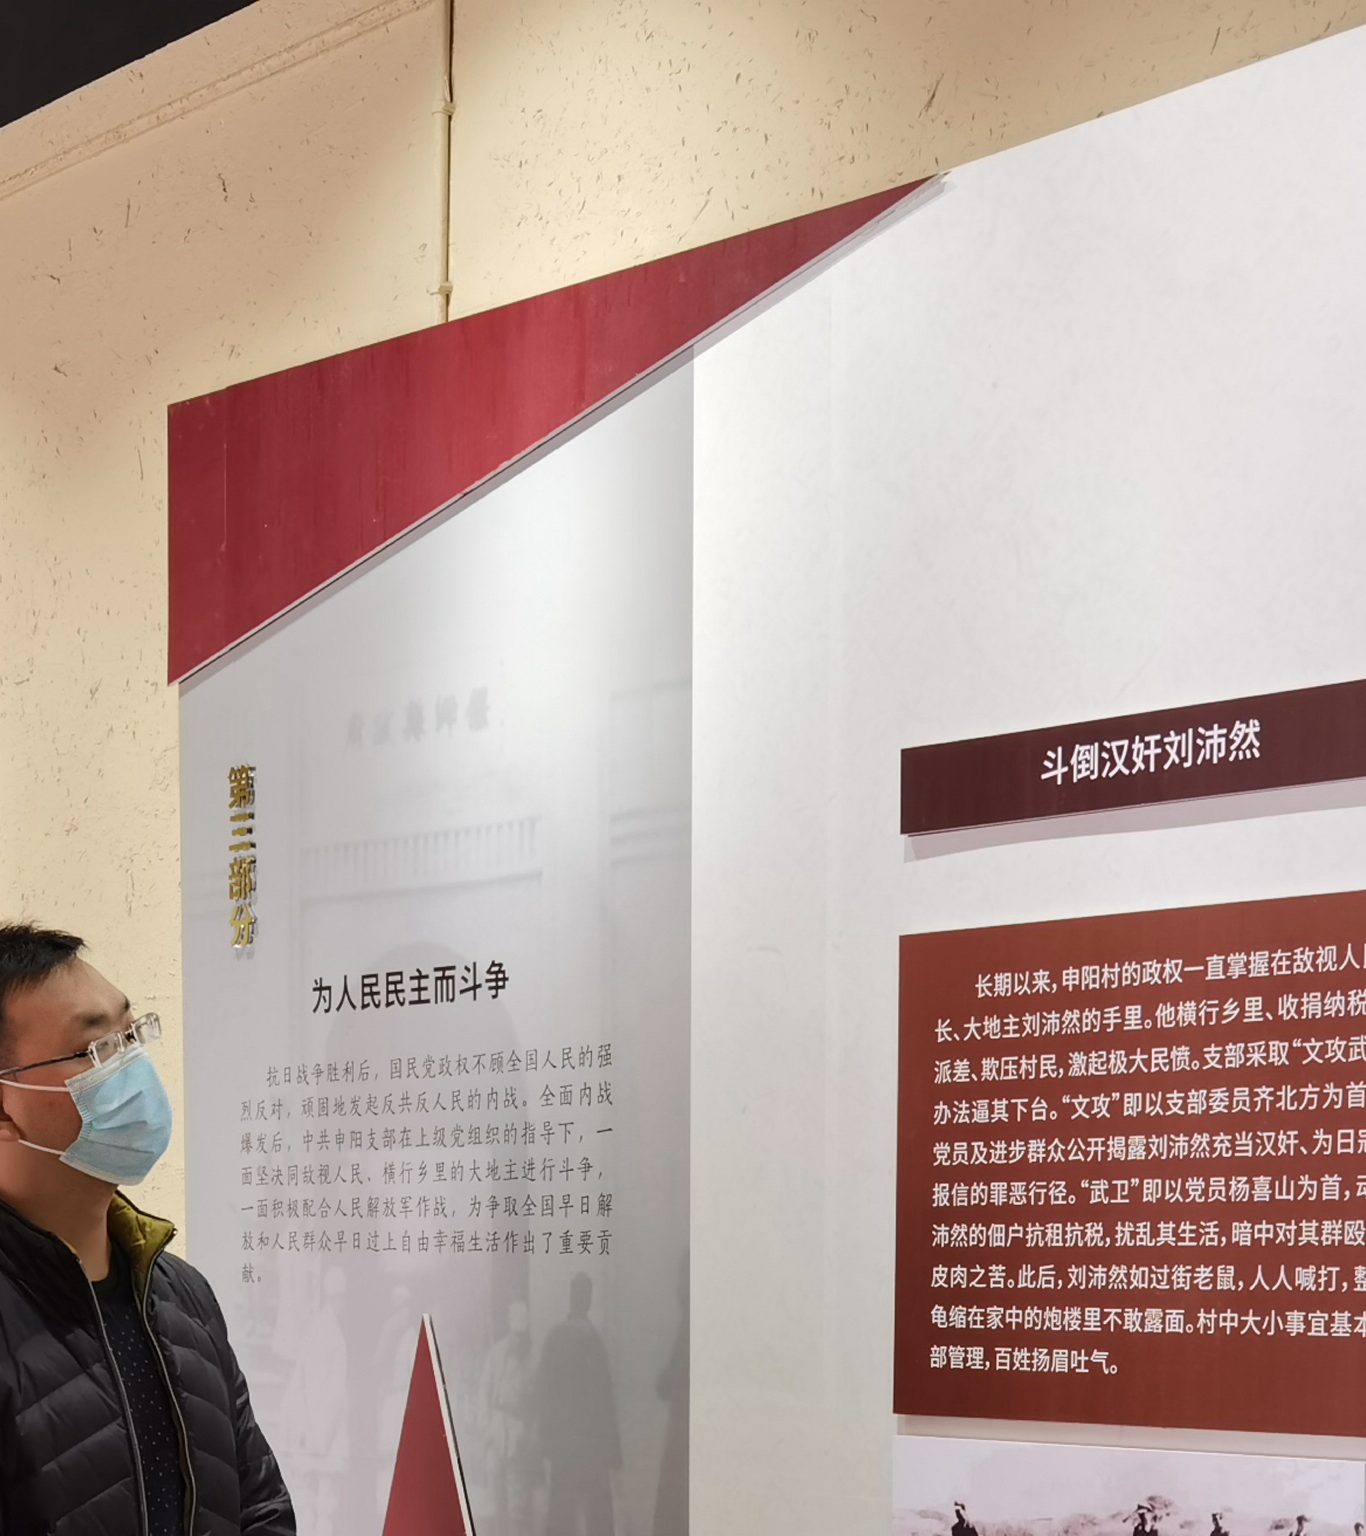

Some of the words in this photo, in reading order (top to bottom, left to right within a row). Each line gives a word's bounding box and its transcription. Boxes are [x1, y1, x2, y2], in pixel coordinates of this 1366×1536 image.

[1039, 718, 1262, 785] 斗倒汉奸刘沛然
[228, 764, 255, 947] 第三部分
[312, 960, 509, 1014] 为人民民主而斗争
[266, 1043, 613, 1087] 抗日战争胜利后，国民党政权不顾全国人民的强
[240, 1080, 614, 1122] 烈反对，顽固地发起反共反人民的内战。全面内战
[240, 1121, 614, 1156] 爆发后，中共申阳支部在上级党组织的指导下，一
[240, 1156, 603, 1187] 面坚决同敌视人民、横行乡里的大地主进行斗争，
[240, 1193, 614, 1220] 一面积极配合人民解放军作战，为争取全国早日解
[240, 1229, 614, 1257] 放和人民群众早日过上自由幸福生活作出了重要贡
[240, 1262, 263, 1284] 献。
[929, 1345, 1119, 1375] 部管理，百姓扬眉吐气。
